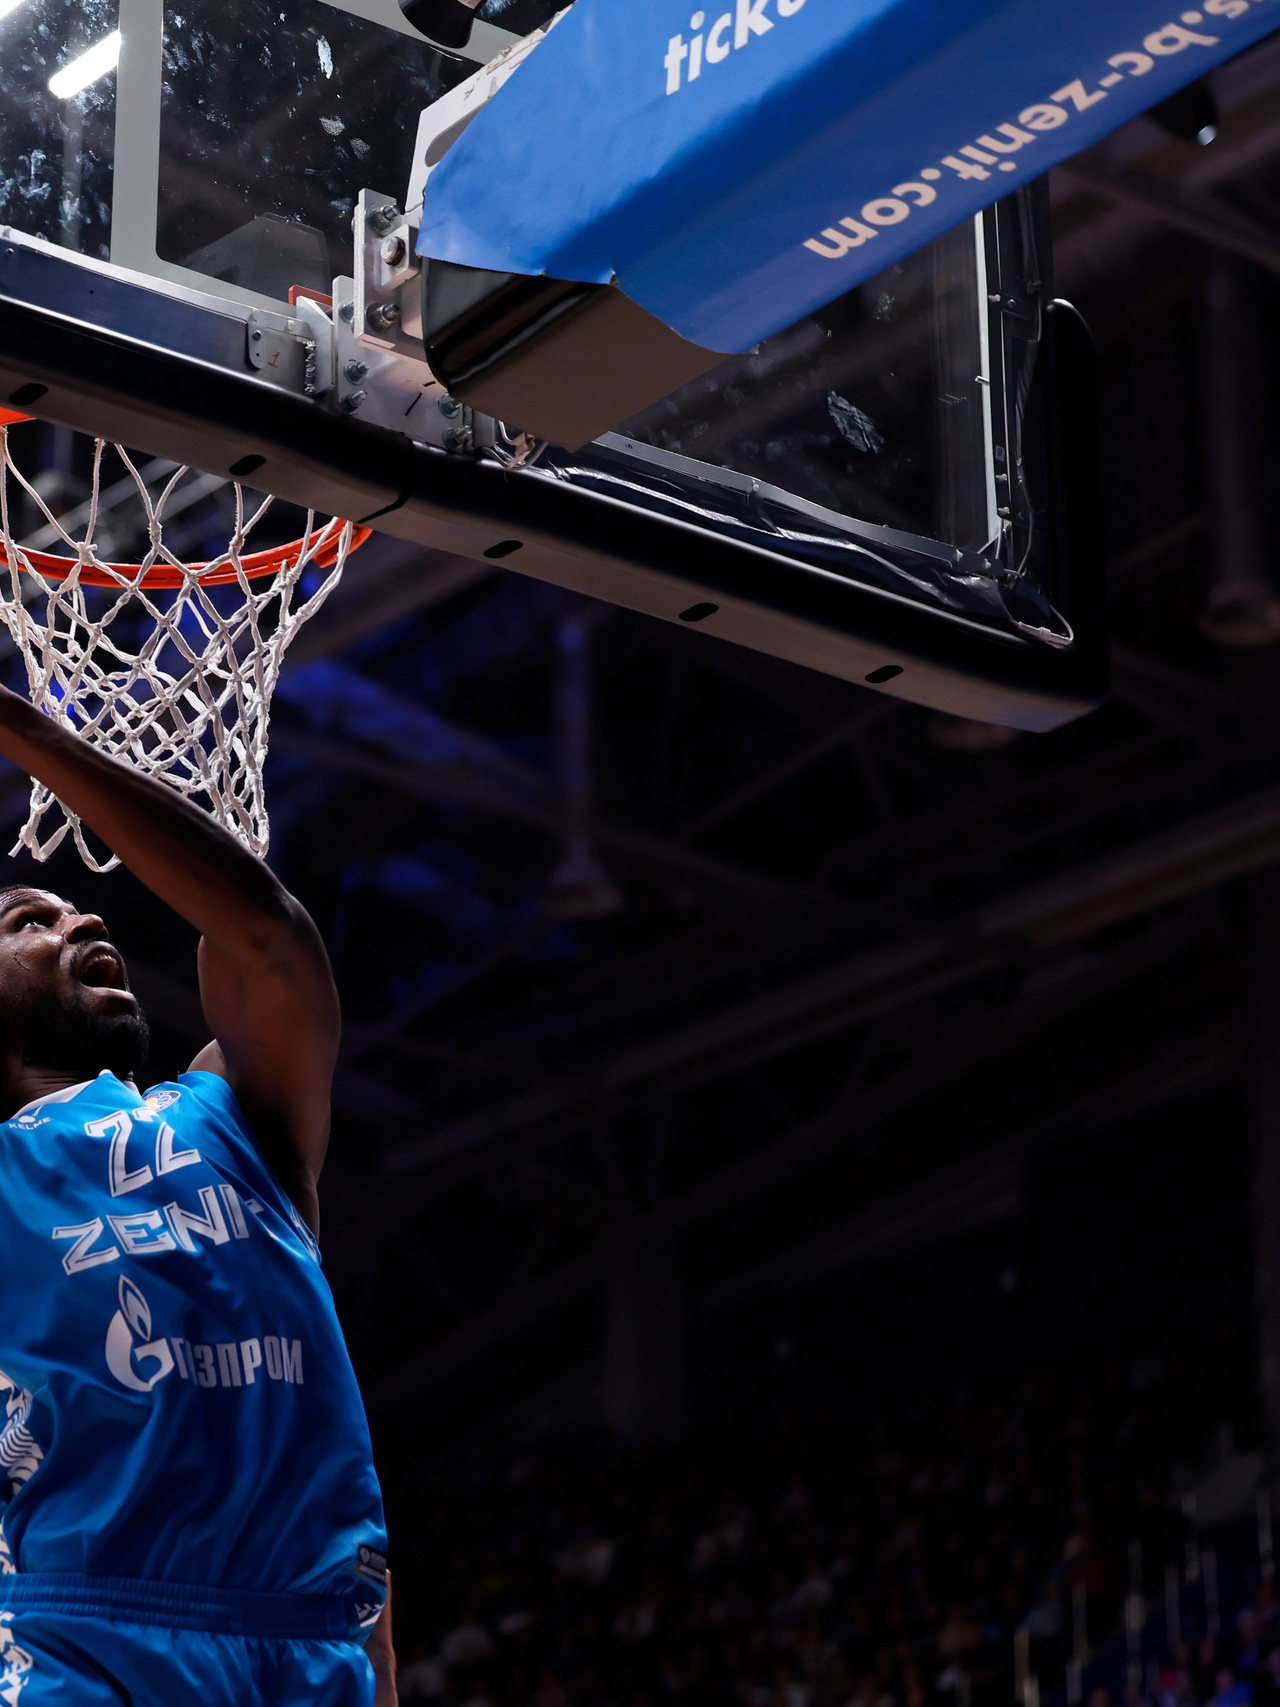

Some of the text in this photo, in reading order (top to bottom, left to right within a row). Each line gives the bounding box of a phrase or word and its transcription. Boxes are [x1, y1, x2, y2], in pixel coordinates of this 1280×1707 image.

[803, 0, 1262, 259] s.bc-zenit.com
[8, 1116, 52, 1131] KELME
[83, 1106, 202, 1198] 22
